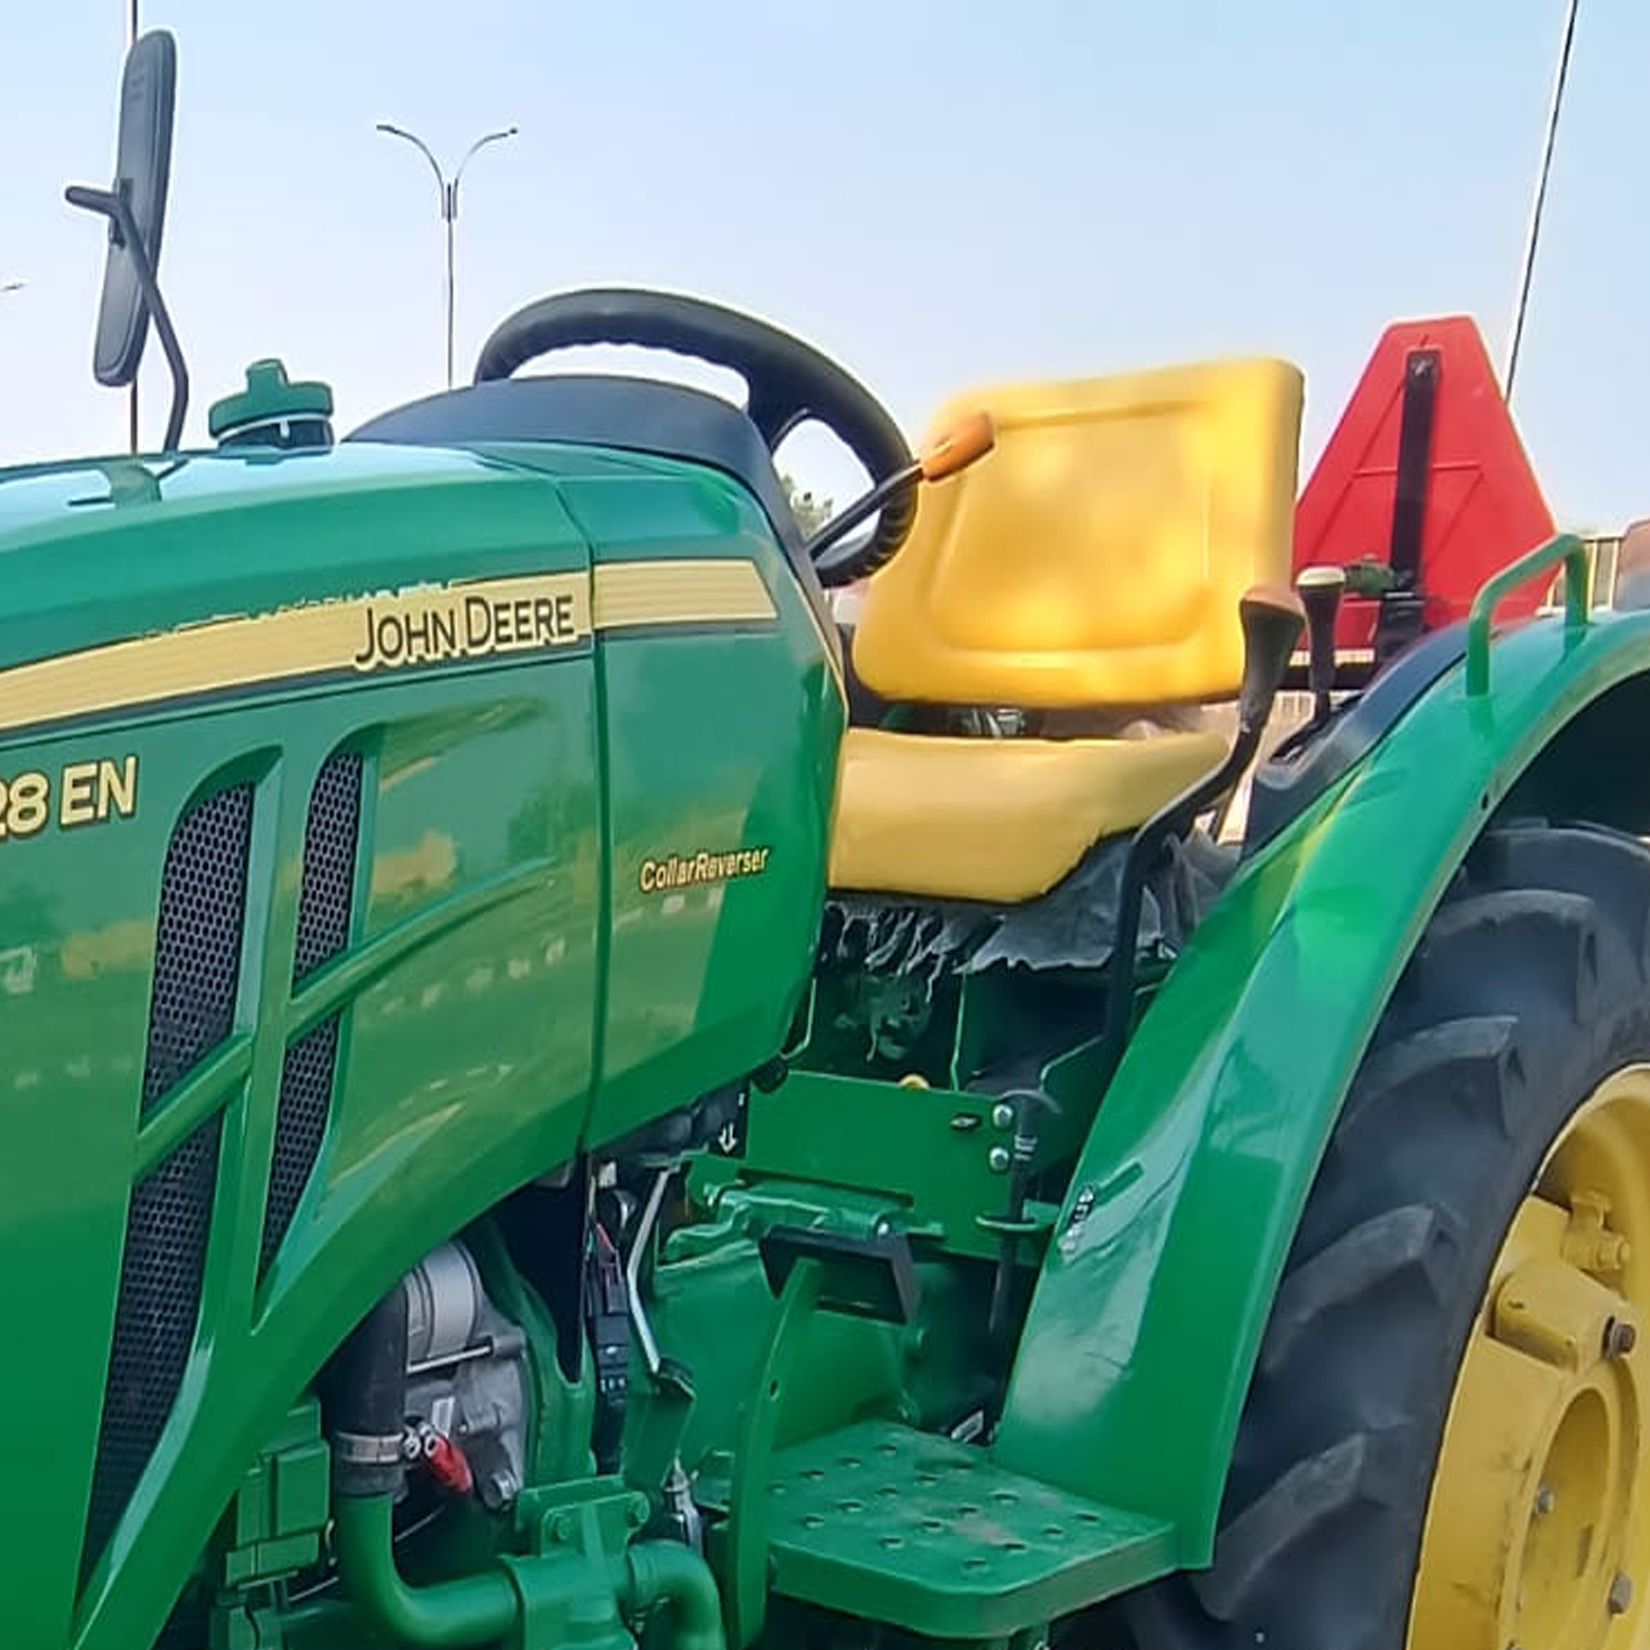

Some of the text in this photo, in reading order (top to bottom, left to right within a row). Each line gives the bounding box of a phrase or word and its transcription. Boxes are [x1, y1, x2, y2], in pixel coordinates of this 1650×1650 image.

[354, 594, 576, 666] JOHN DEERE
[58, 754, 139, 827] EN
[639, 847, 770, 893] CollarReverser
